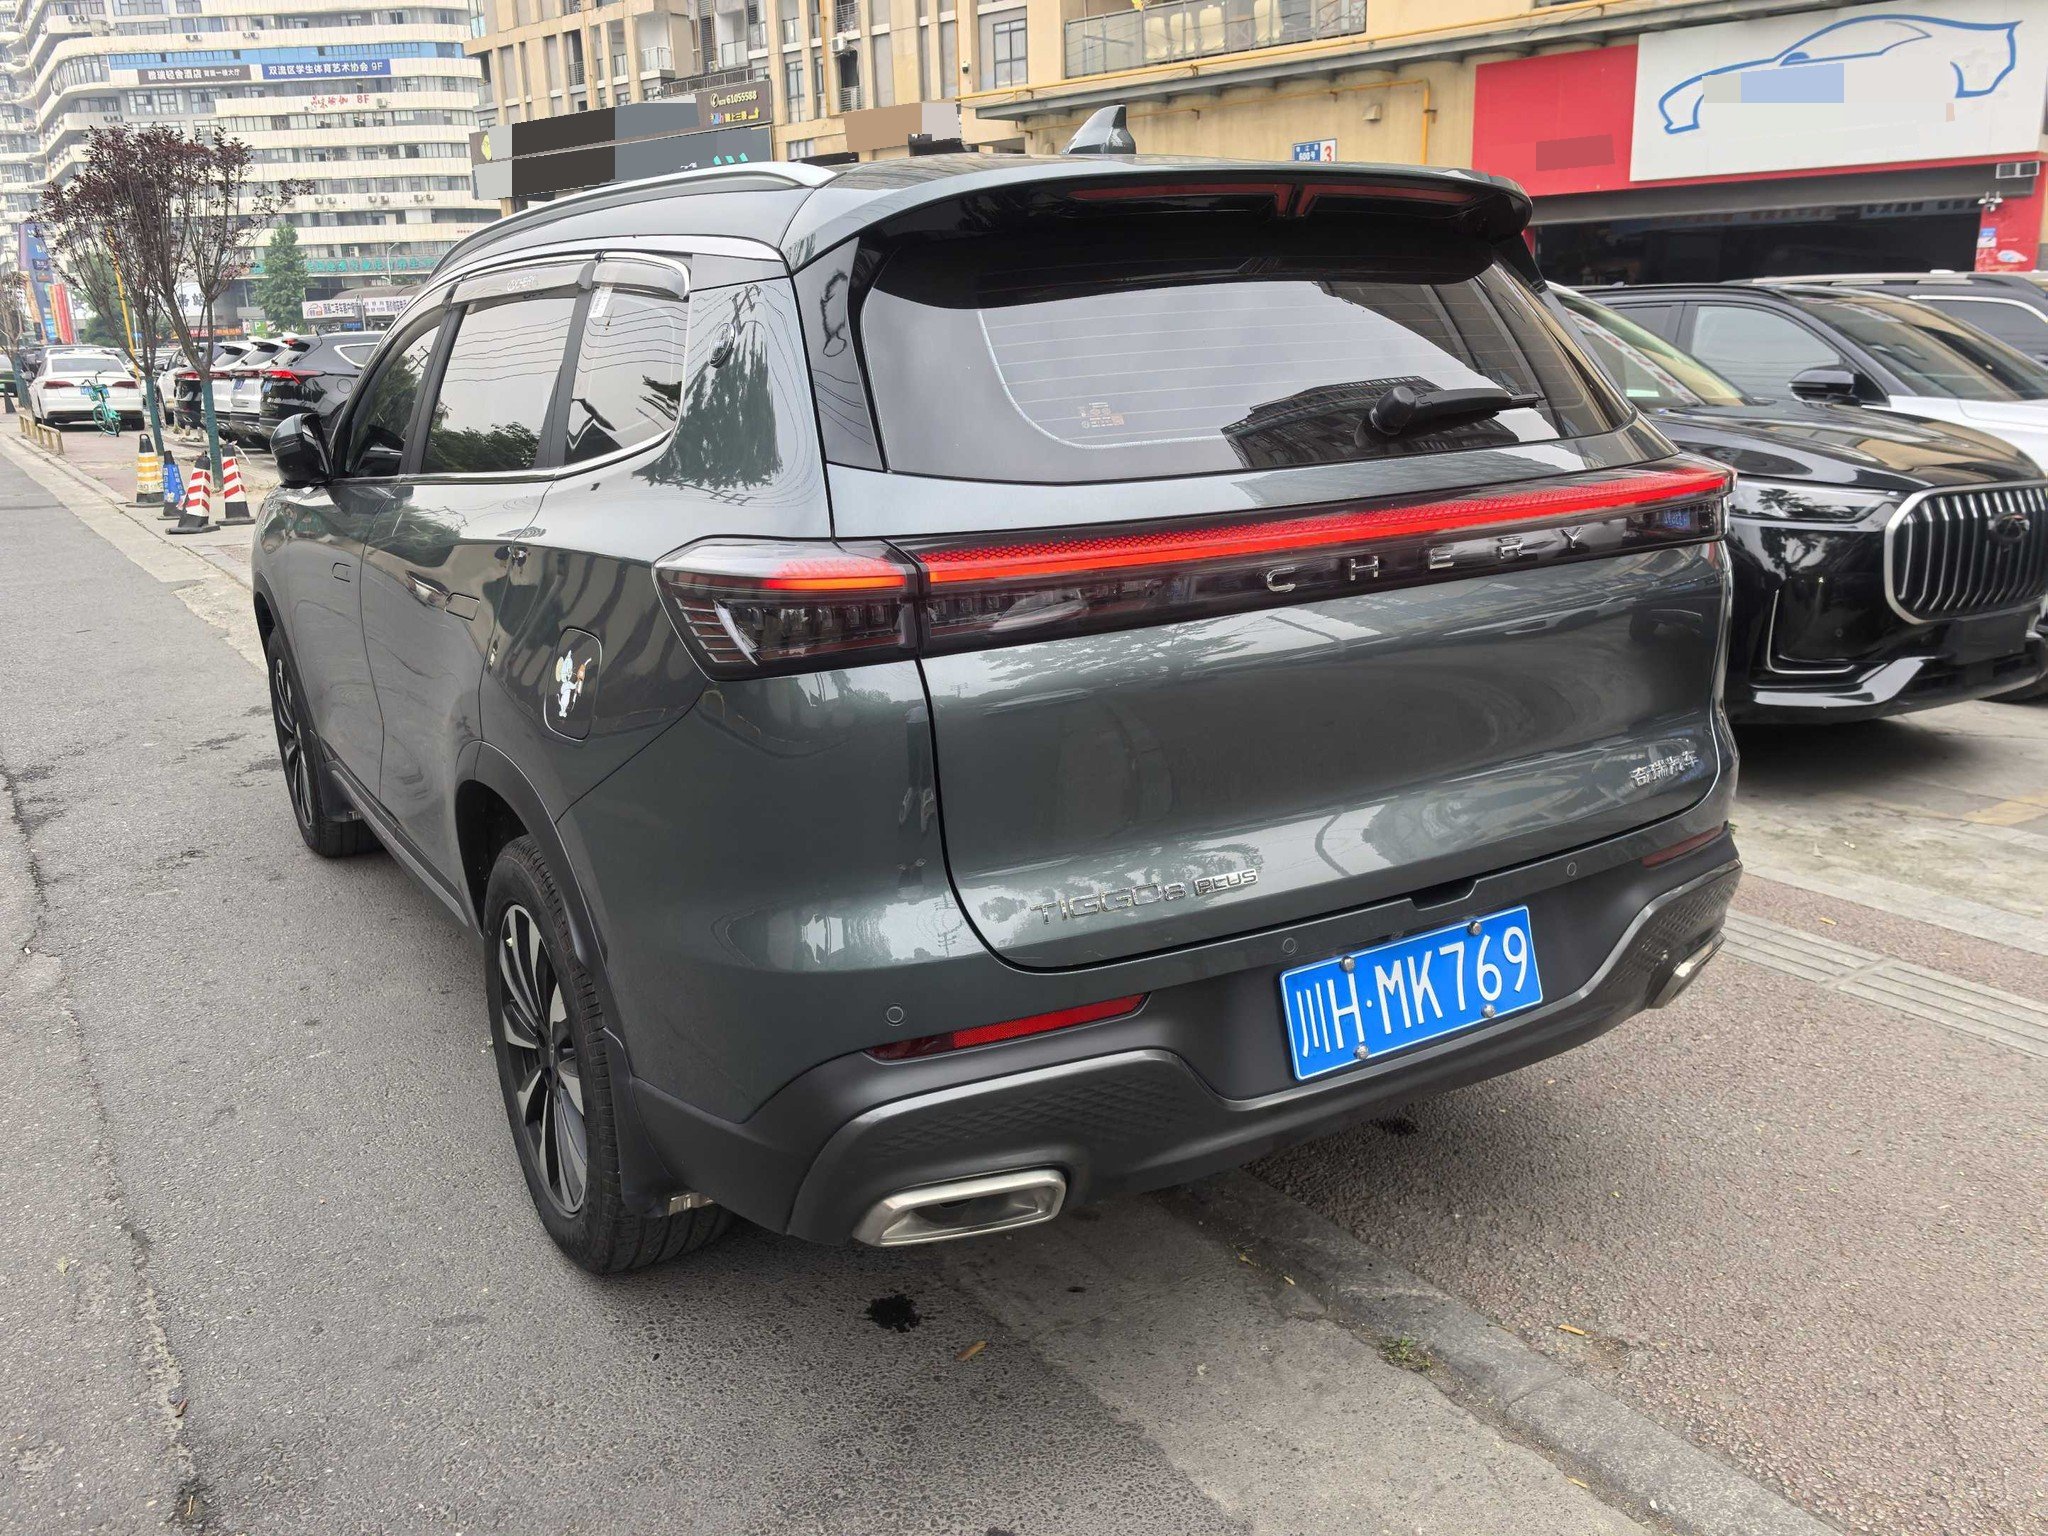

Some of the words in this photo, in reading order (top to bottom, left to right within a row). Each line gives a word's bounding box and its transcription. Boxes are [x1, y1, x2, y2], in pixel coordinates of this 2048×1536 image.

[268, 62, 369, 75] 双流区学生体育艺术协会
[371, 61, 383, 71] 9F
[1325, 146, 1332, 162] 3
[1266, 526, 1584, 592] CHERY
[1628, 750, 1700, 787] 奇瑞汽车
[1194, 868, 1258, 896] PLUS
